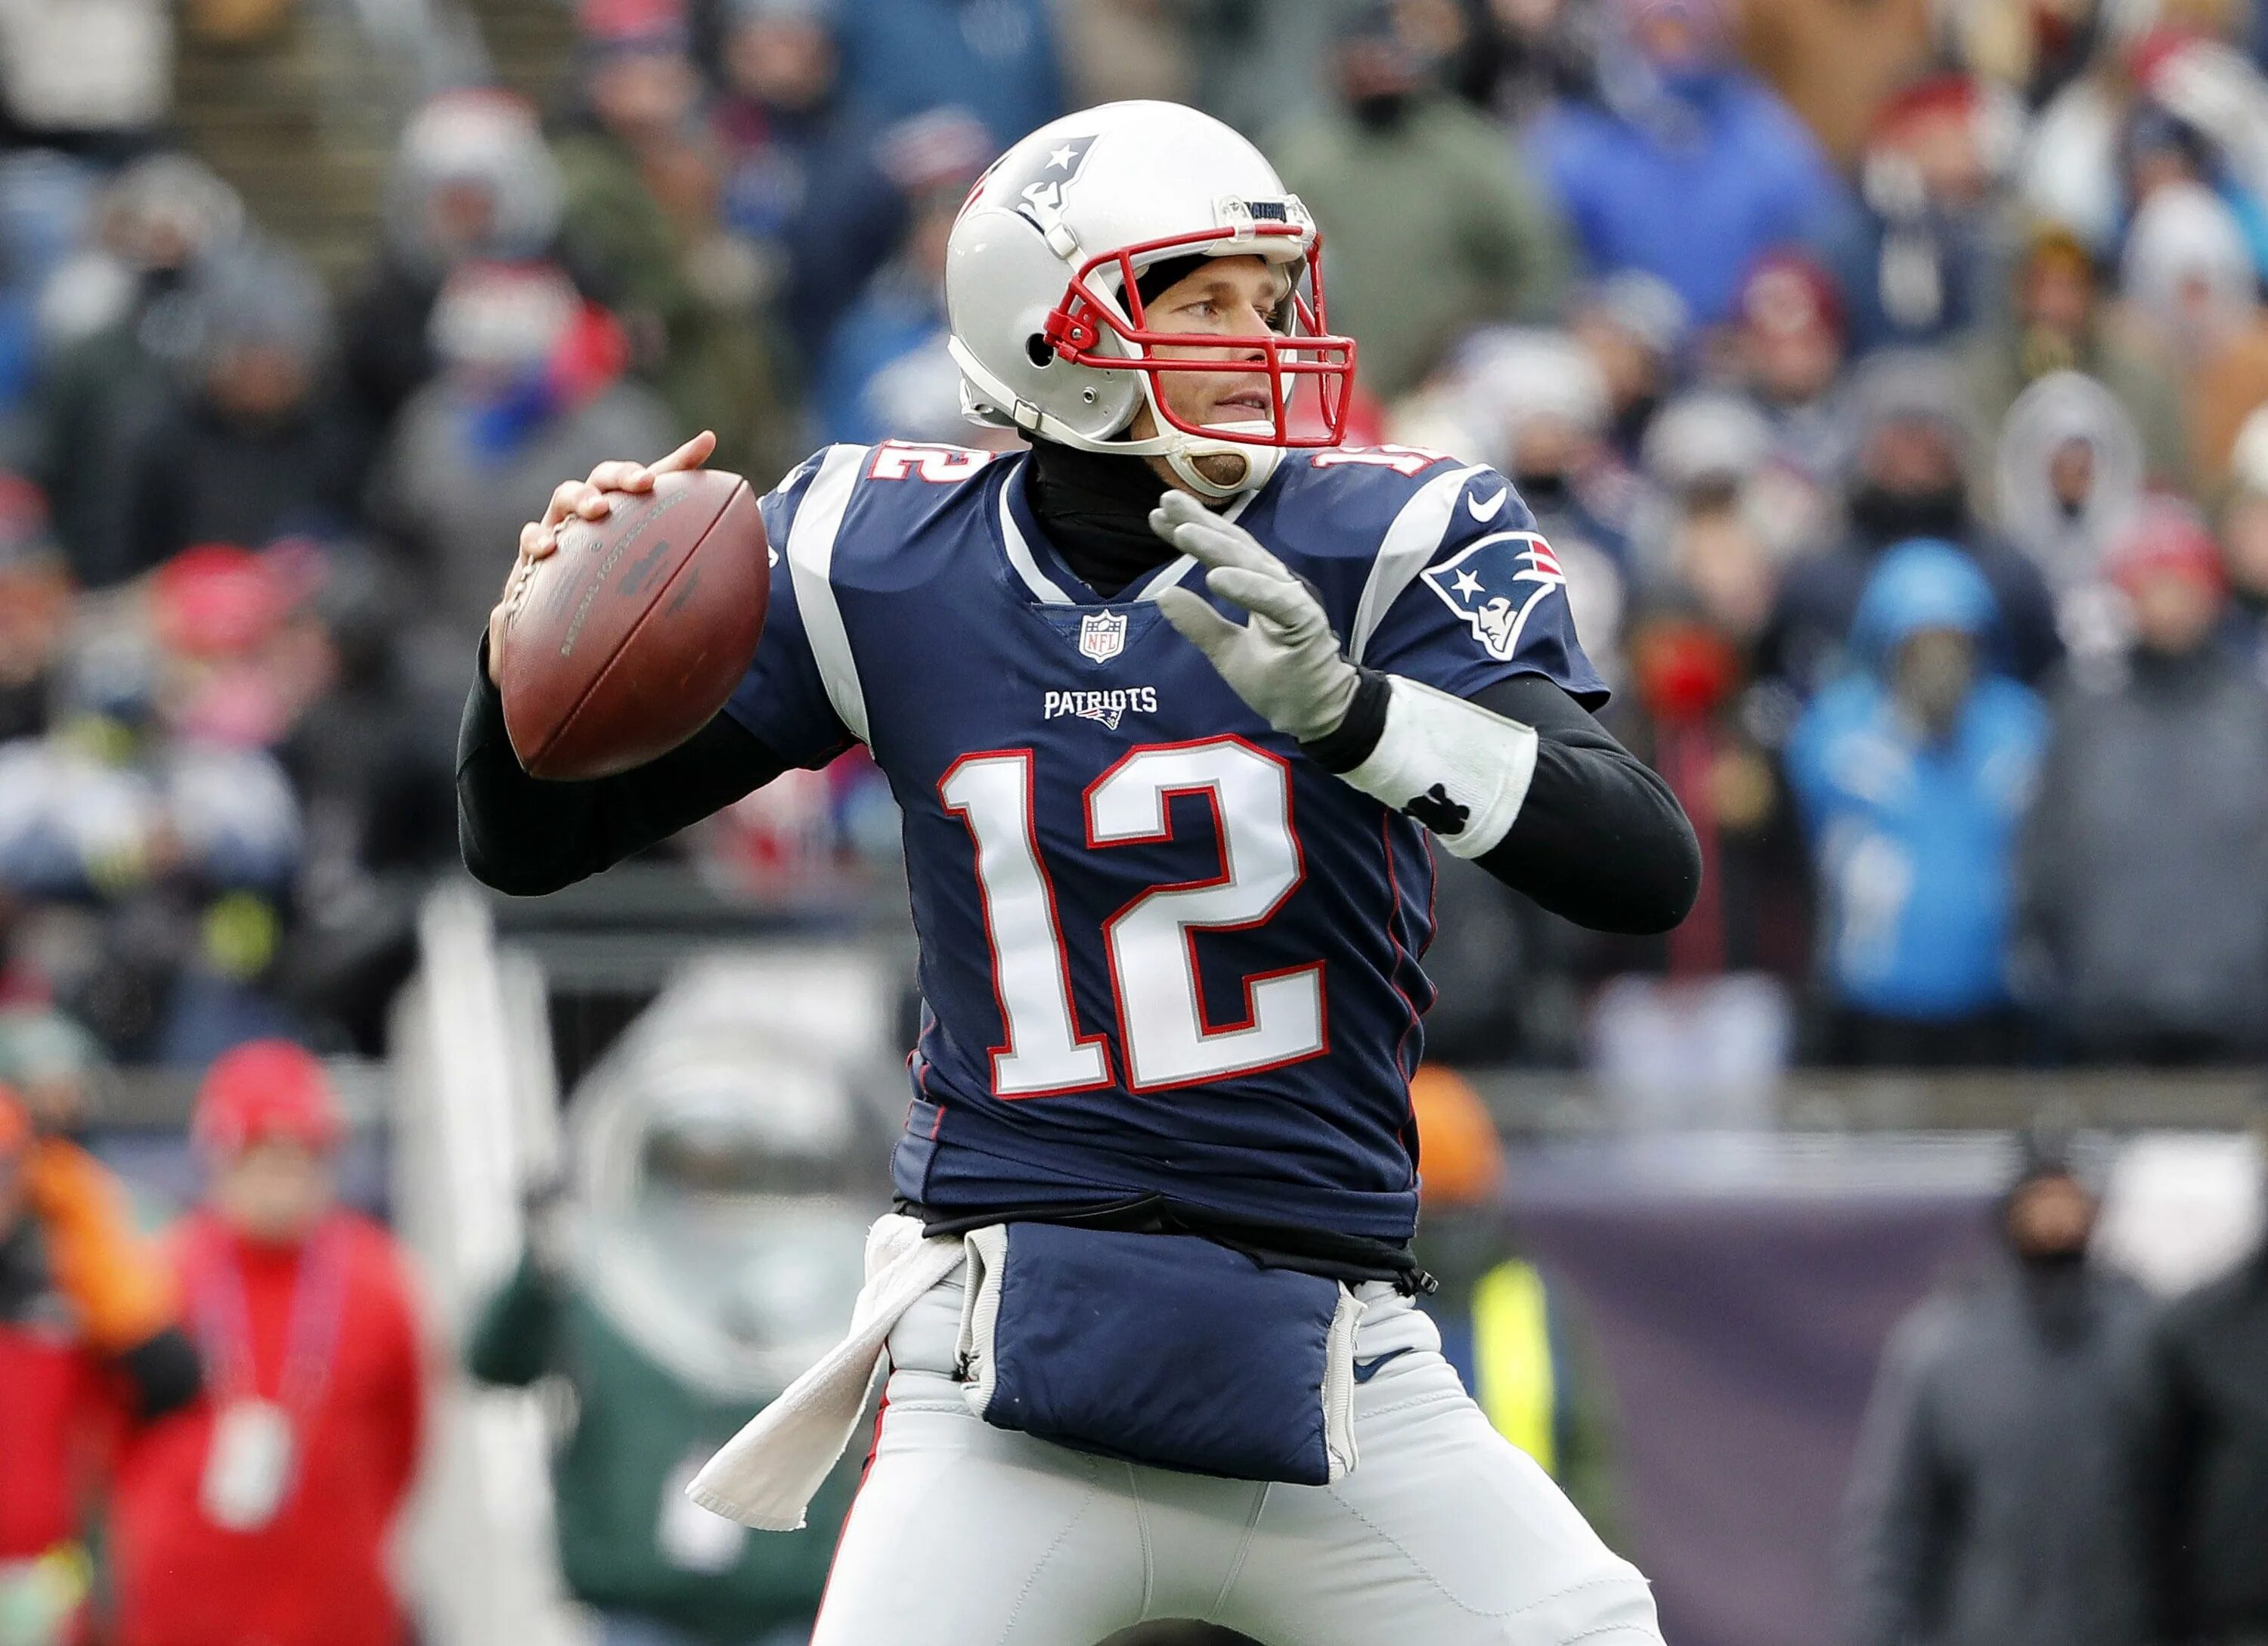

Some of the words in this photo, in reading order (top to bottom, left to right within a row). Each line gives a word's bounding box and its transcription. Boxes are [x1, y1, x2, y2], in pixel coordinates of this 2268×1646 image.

[1088, 633, 1117, 653] NFL
[1044, 686, 1157, 719] PATRIOTS
[937, 733, 1330, 1100] 12
